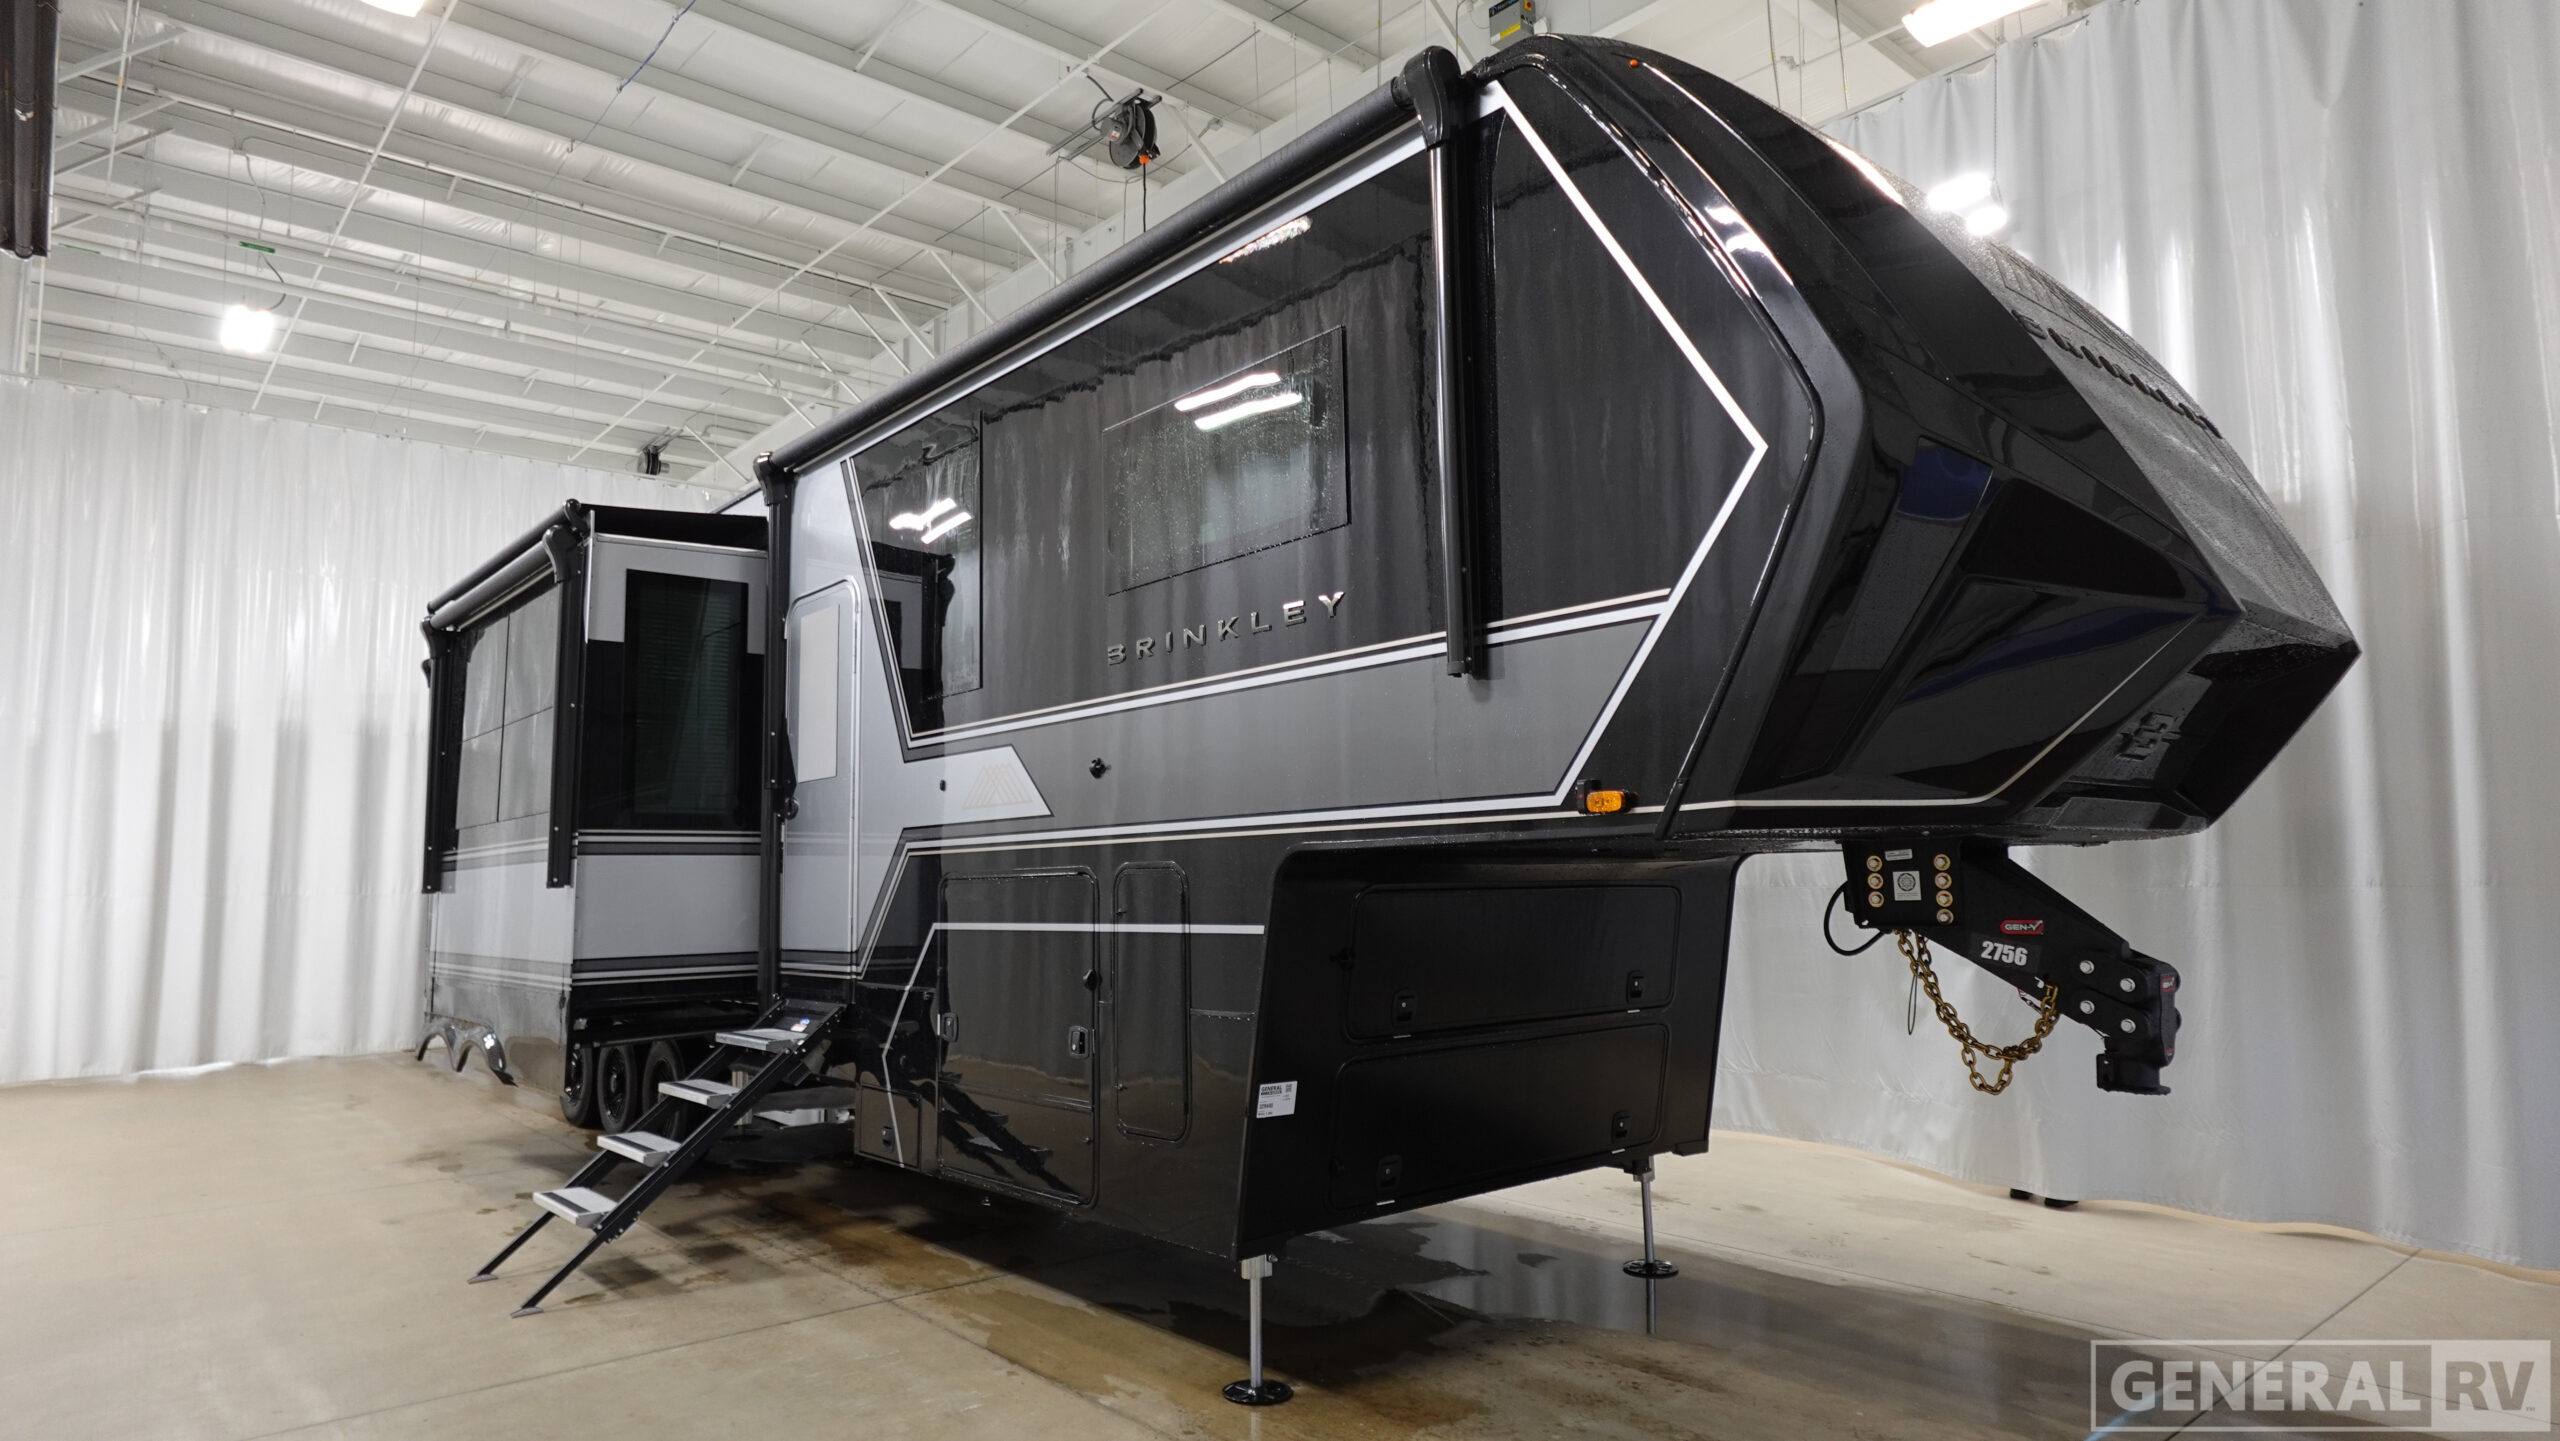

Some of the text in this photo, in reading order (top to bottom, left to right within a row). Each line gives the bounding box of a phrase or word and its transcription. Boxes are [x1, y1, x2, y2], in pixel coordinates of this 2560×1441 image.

[1107, 591, 1345, 666] BRINKLEY
[2004, 920, 2043, 931] GEN-Y
[1981, 941, 2028, 966] 2756
